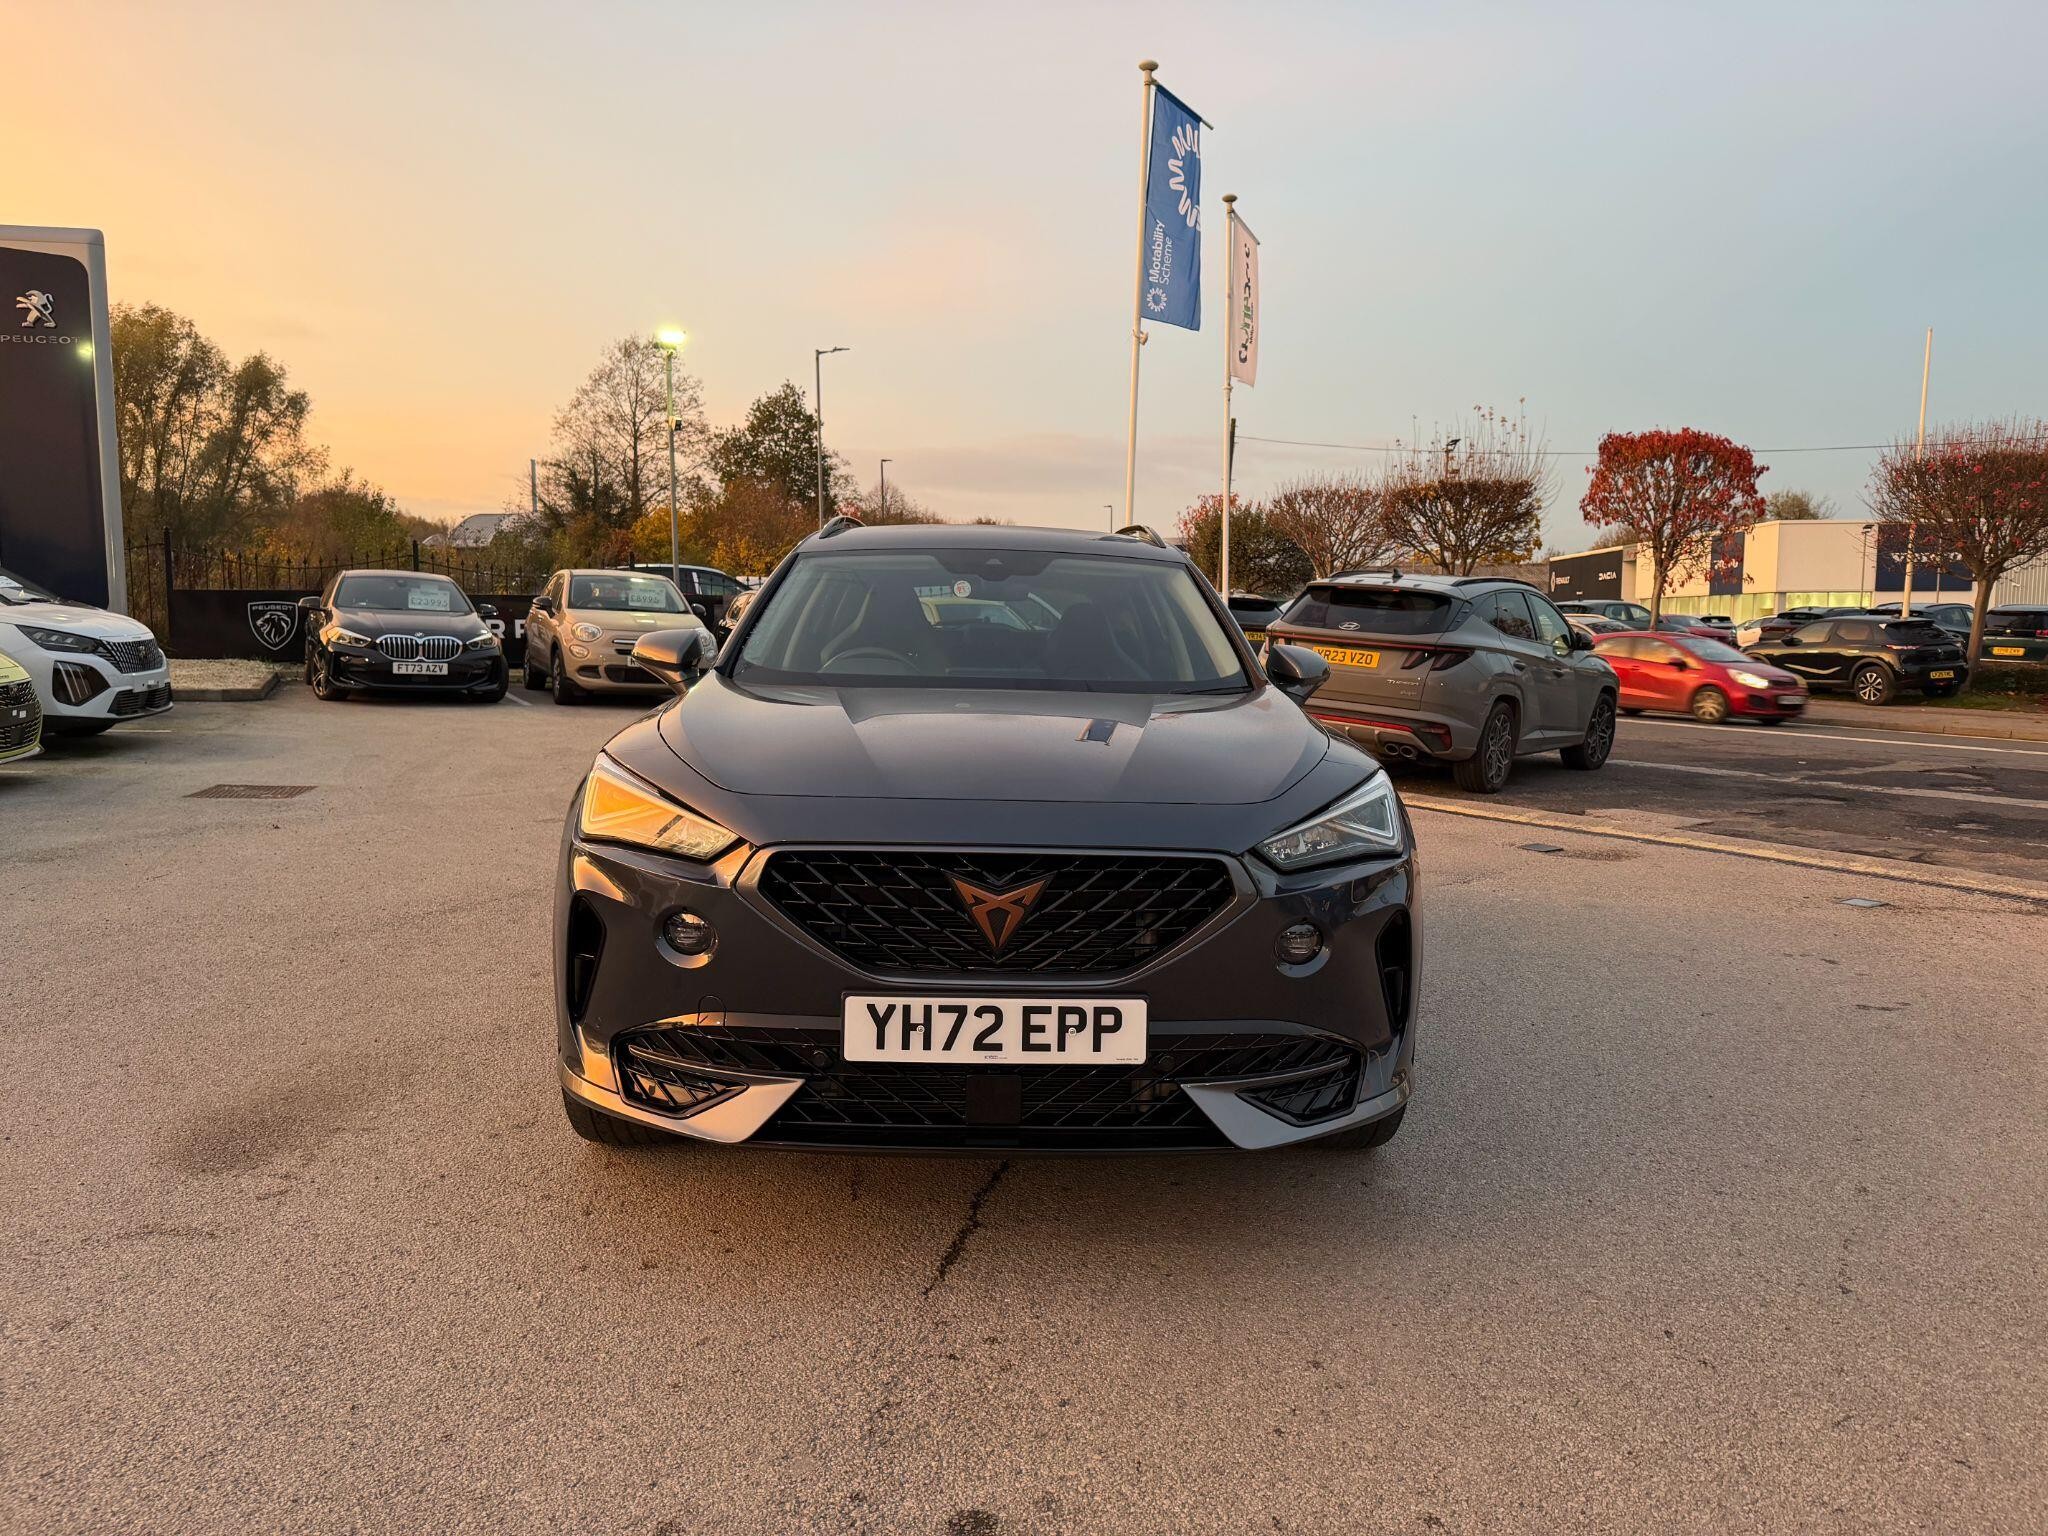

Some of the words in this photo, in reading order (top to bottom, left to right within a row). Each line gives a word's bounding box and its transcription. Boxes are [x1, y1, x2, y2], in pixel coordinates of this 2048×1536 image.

[1149, 219, 1165, 283] Motability
[1159, 236, 1173, 285] Scheme
[0, 334, 81, 345] PEUGEOT
[1598, 571, 1617, 581] DACIA
[1350, 651, 1374, 666] VZO
[397, 663, 423, 673] FT73
[425, 664, 444, 673] AZV
[866, 1003, 1004, 1052] YH72
[1021, 1005, 1123, 1053] EPP
